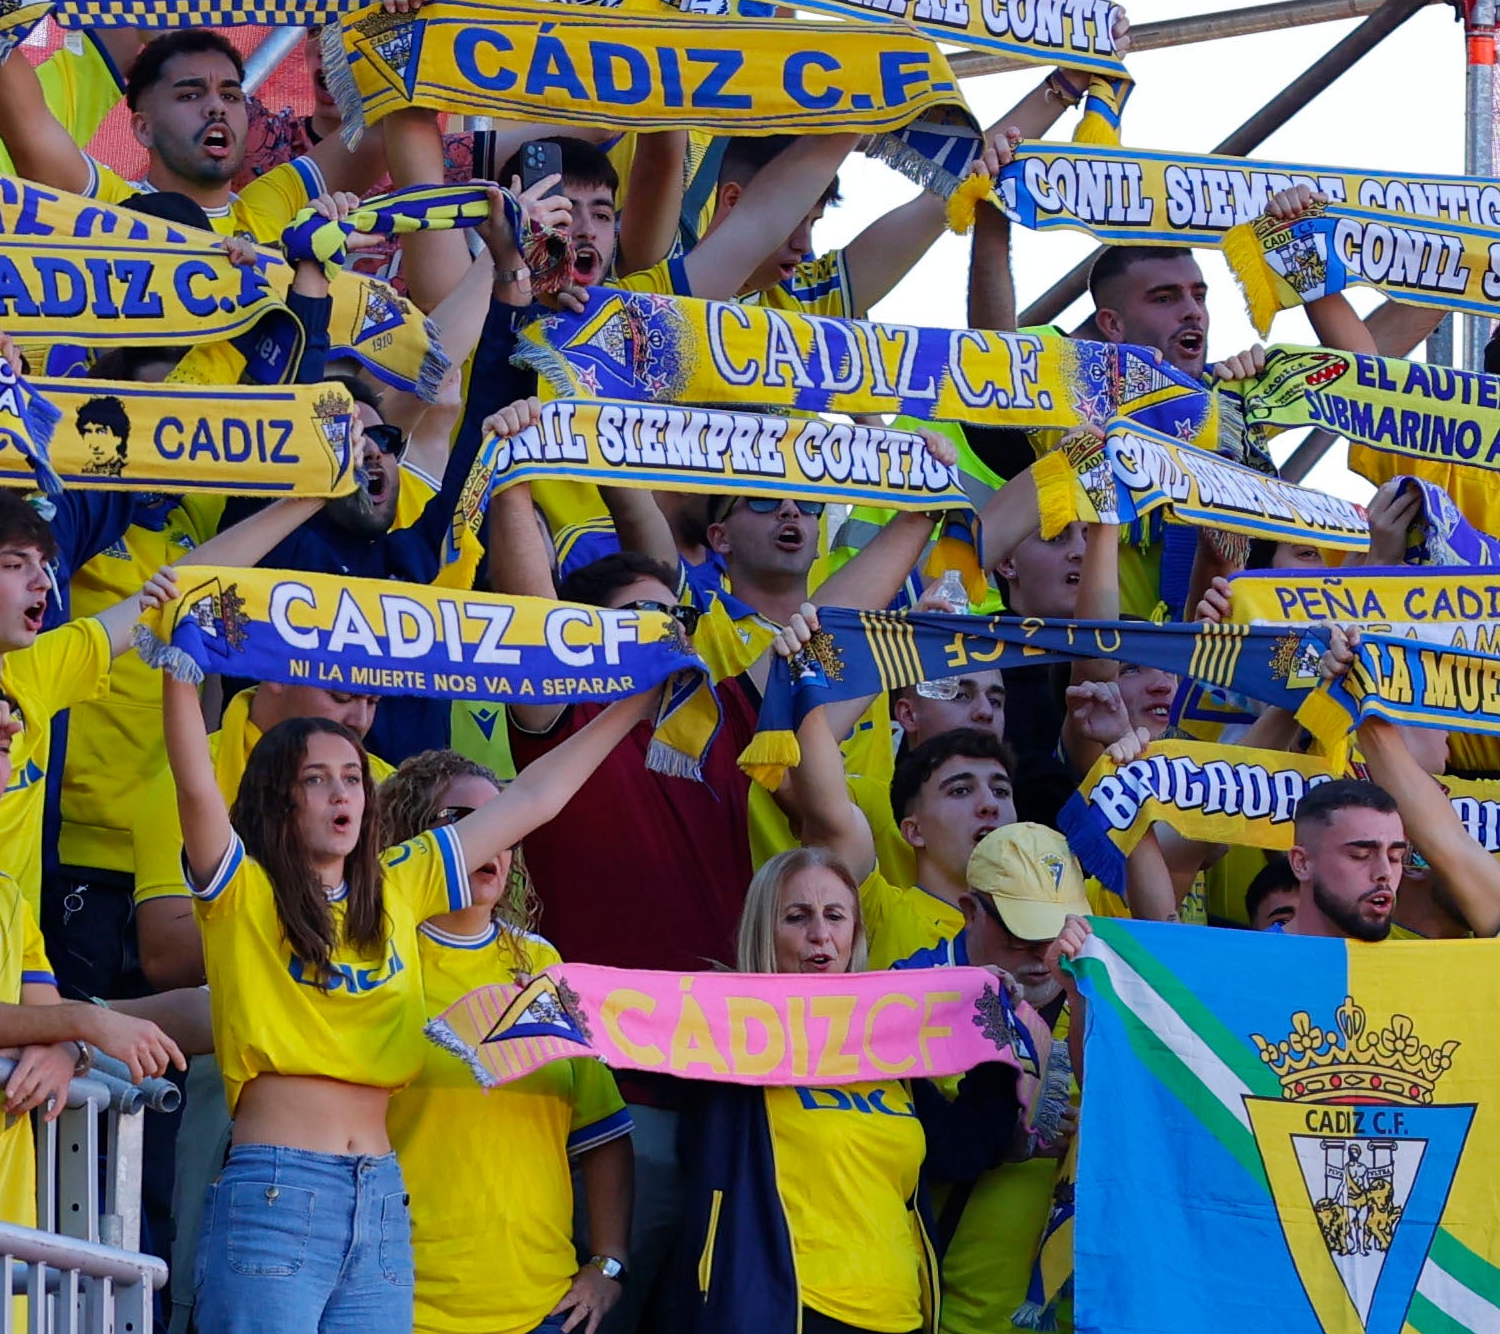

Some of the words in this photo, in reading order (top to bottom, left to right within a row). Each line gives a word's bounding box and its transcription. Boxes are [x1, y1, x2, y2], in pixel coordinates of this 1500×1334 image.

[453, 22, 752, 112] CÁDIZ
[781, 49, 955, 111] C.F.
[1022, 157, 1153, 226] CONIL
[1332, 217, 1471, 293] CONIL
[705, 301, 942, 401] CADIZ
[947, 328, 1054, 411] C.F.
[1356, 353, 1396, 392] EL
[154, 415, 300, 464] CADIZ
[596, 407, 787, 481] SIEMPRE
[1302, 389, 1483, 460] SUBMARINO
[268, 581, 523, 666] CADIZ
[544, 607, 642, 668] CF
[1277, 578, 1386, 620] PEÑA
[289, 658, 312, 681] NI
[318, 662, 345, 684] LA
[350, 667, 428, 691] MUERTE
[432, 673, 480, 695] NOS
[484, 676, 513, 695] VA
[519, 677, 536, 696] A
[541, 674, 636, 699] SEPARAR
[1305, 1108, 1367, 1135] CADIZ
[1371, 1111, 1410, 1136] C.F.
